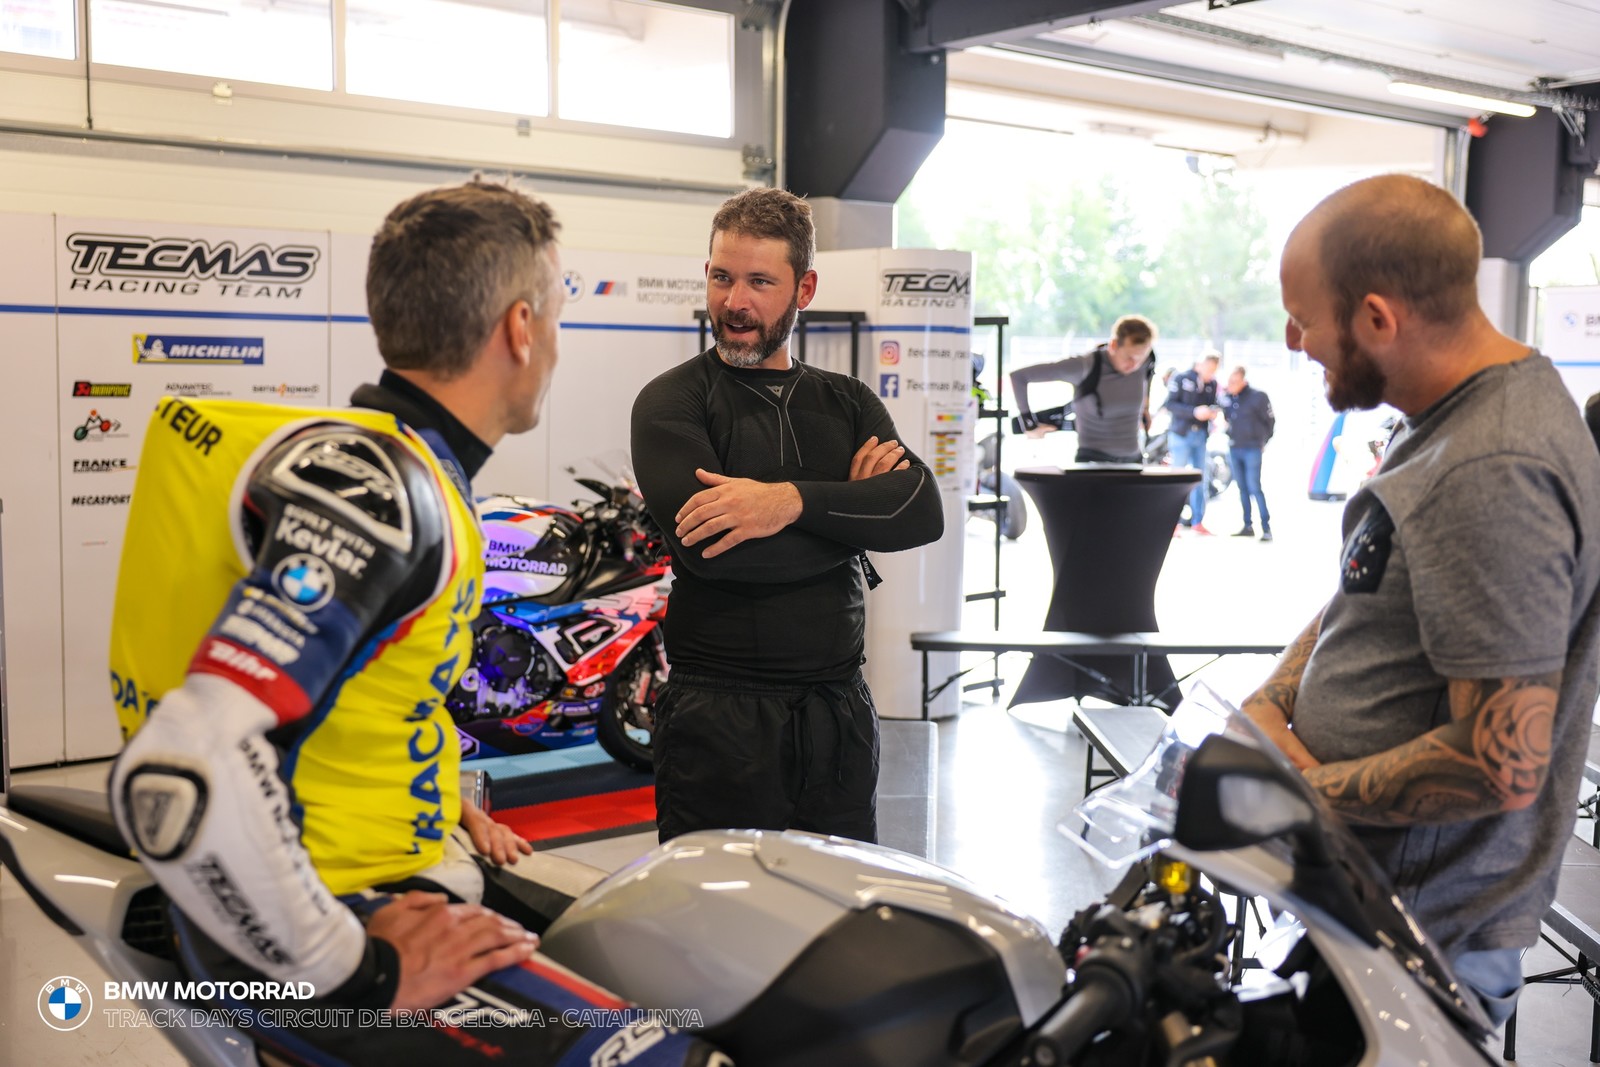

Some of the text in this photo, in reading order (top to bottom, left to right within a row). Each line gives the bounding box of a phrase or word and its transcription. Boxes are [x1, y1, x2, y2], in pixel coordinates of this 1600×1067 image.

[68, 235, 319, 282] TECMAS
[70, 278, 302, 299] RACING TEAM
[638, 277, 664, 288] BMW
[882, 271, 971, 297] TECM
[636, 293, 707, 304] MOTORSPOR
[881, 299, 955, 308] RACING
[168, 344, 262, 359] MICHELIN
[154, 398, 223, 457] TEUR
[73, 460, 127, 468] FRANCE
[275, 517, 369, 580] Kevlar
[488, 540, 526, 557] BMW
[484, 555, 568, 576] MOTORRAD
